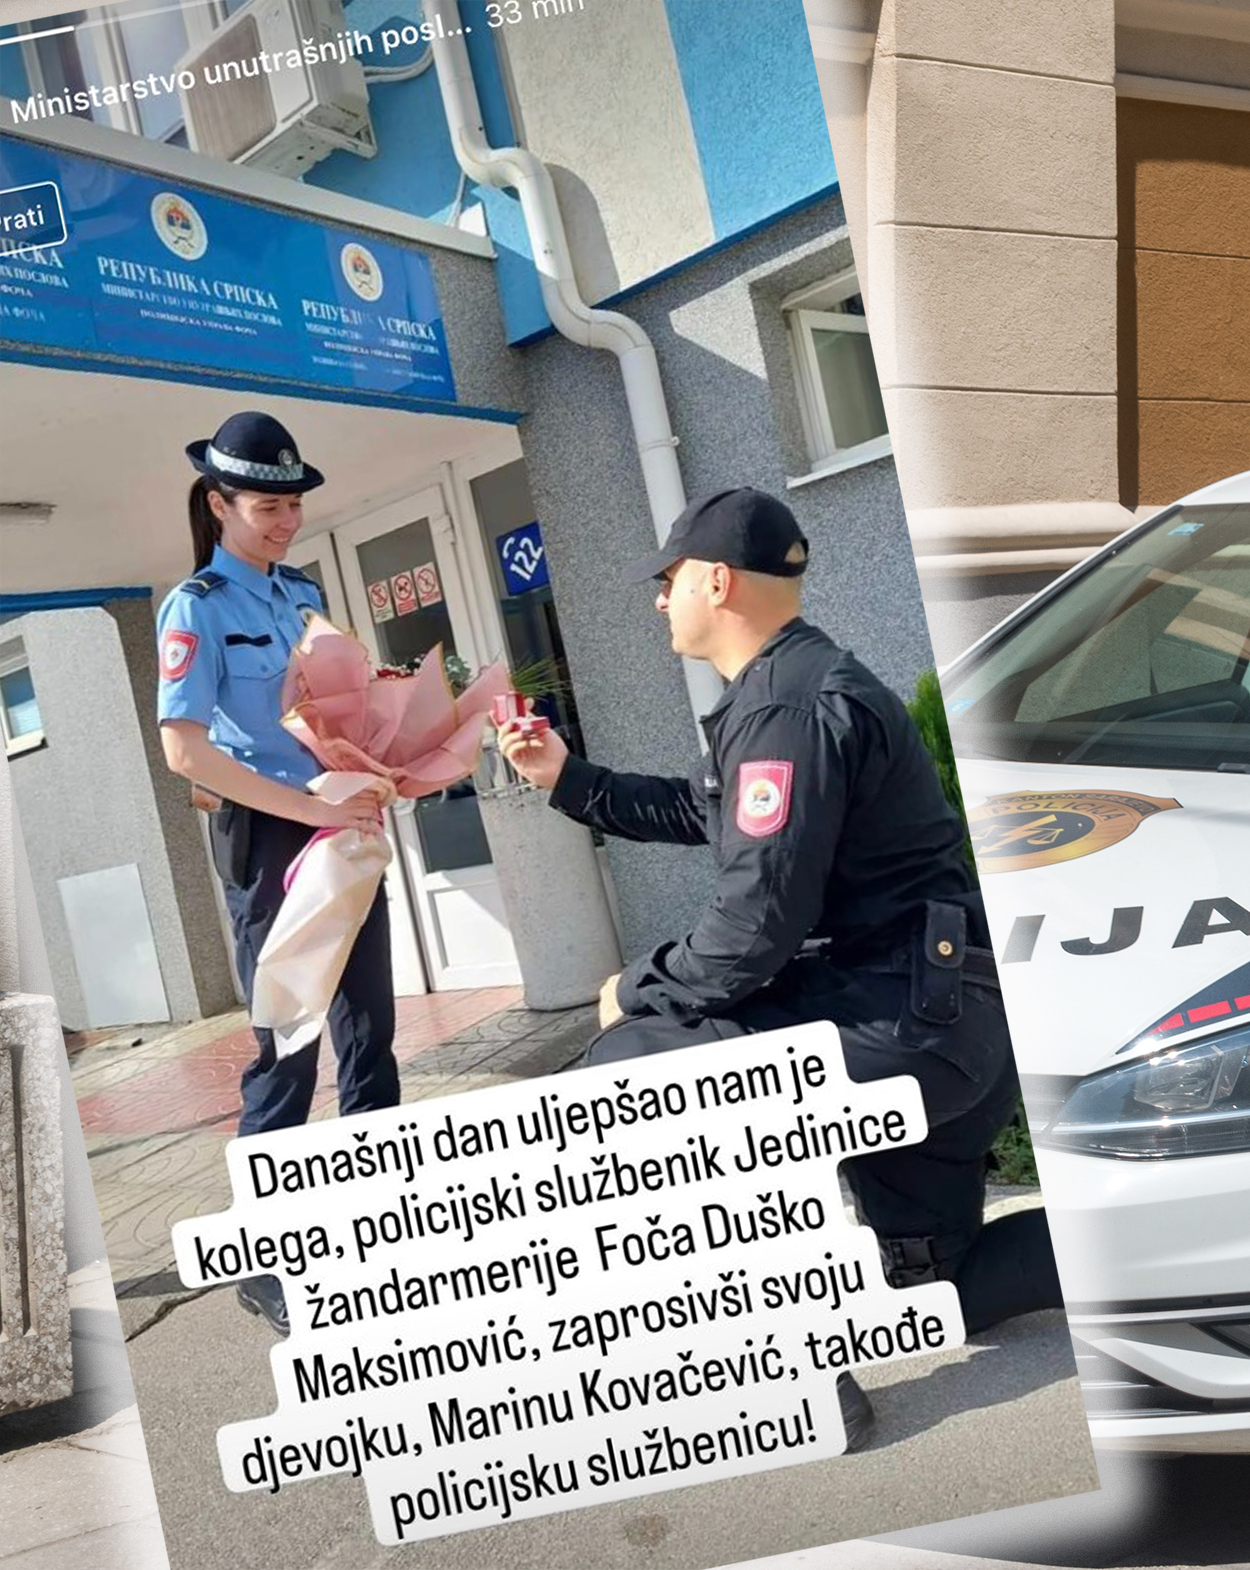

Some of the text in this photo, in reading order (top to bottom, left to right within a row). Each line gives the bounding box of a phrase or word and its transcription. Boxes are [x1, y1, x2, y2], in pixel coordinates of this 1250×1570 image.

[97, 256, 279, 310] РЕПУБЛИКА СРПСКА
[301, 299, 386, 331] РЕПУБЛИА
[510, 537, 543, 581] 122
[992, 801, 1126, 821] POLICIJA
